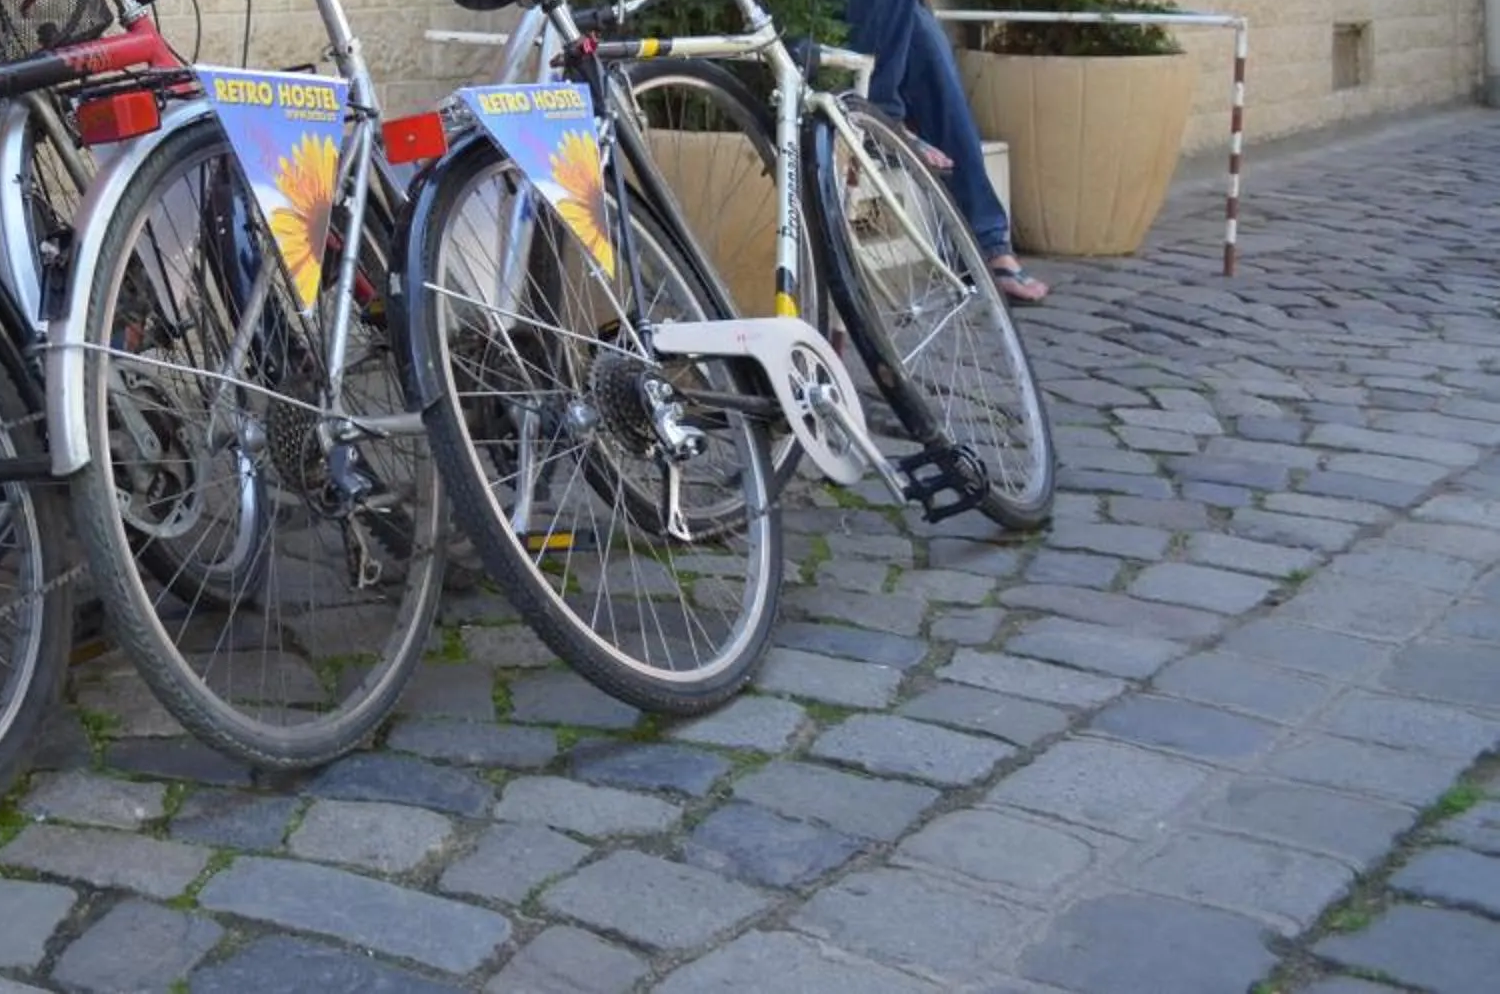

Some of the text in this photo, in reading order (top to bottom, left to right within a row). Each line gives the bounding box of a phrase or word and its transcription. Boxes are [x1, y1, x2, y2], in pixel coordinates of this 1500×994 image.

[214, 77, 341, 110] RETRO HOSTEL
[478, 92, 532, 115] RETRO
[532, 89, 584, 111] HOSTEL
